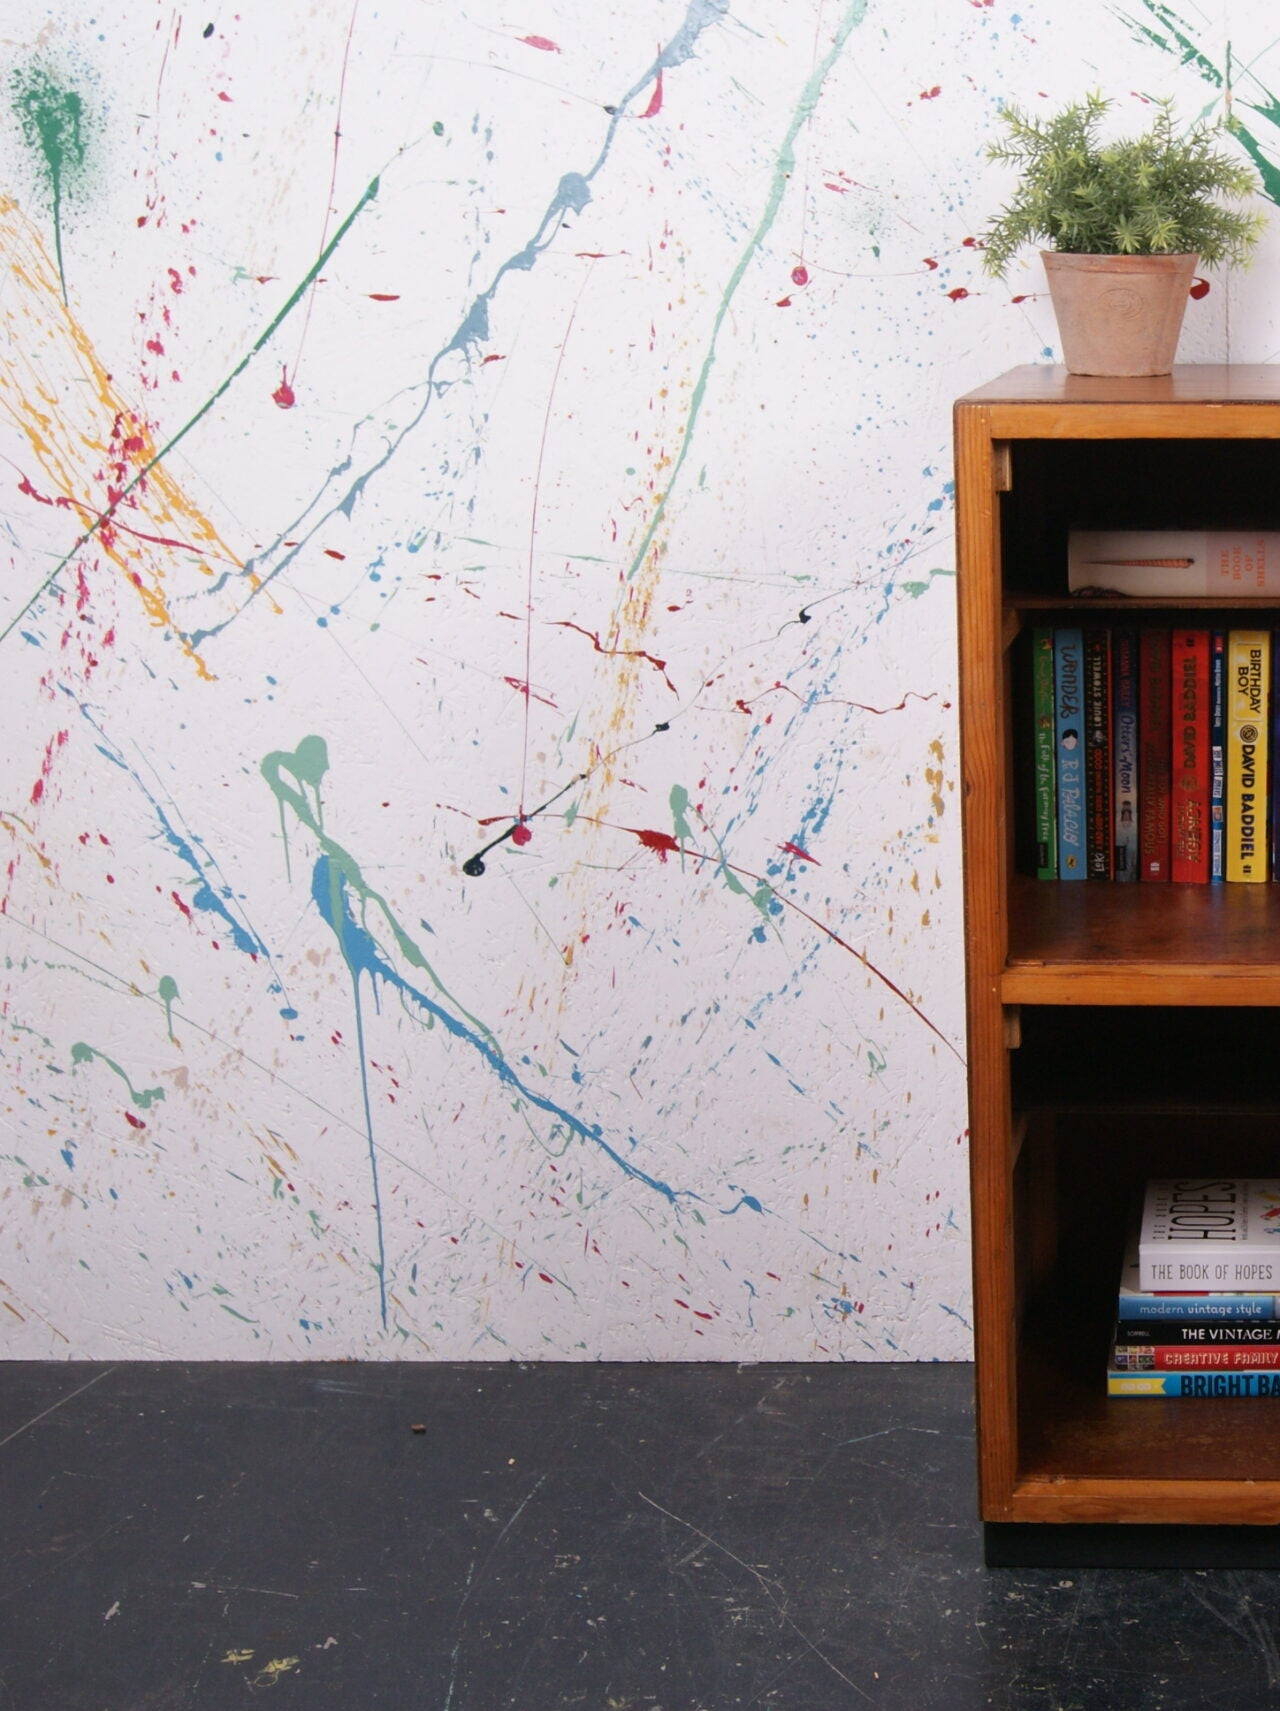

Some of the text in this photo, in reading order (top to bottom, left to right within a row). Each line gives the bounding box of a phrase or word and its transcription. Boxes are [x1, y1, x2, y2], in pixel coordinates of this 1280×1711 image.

[1219, 550, 1229, 576] THE
[1232, 547, 1242, 580] BOOK
[1244, 555, 1253, 572] OF
[1256, 539, 1265, 587] SHELLS
[1092, 656, 1102, 728] LOUIE STOWELL
[1237, 666, 1250, 696] BOY
[1249, 649, 1262, 714] BIRTHDAY
[1183, 656, 1197, 769] DAVID BADDIEL
[1119, 756, 1134, 794] Moon
[1240, 745, 1255, 860] DAVID BADDIEL
[1145, 810, 1155, 855] FAMOUS
[1186, 799, 1202, 864] AGENCY
[1168, 1181, 1237, 1241] HOPES
[1151, 1263, 1273, 1280] THE BOOK OF HOPES
[1139, 1301, 1262, 1317] modern vintage style
[1182, 1328, 1206, 1340] THE
[1209, 1328, 1273, 1341] VINTAGE
[1165, 1352, 1229, 1365] CREATIVE
[1234, 1352, 1279, 1365] FAMILY
[1180, 1375, 1254, 1397] BRIGHT
